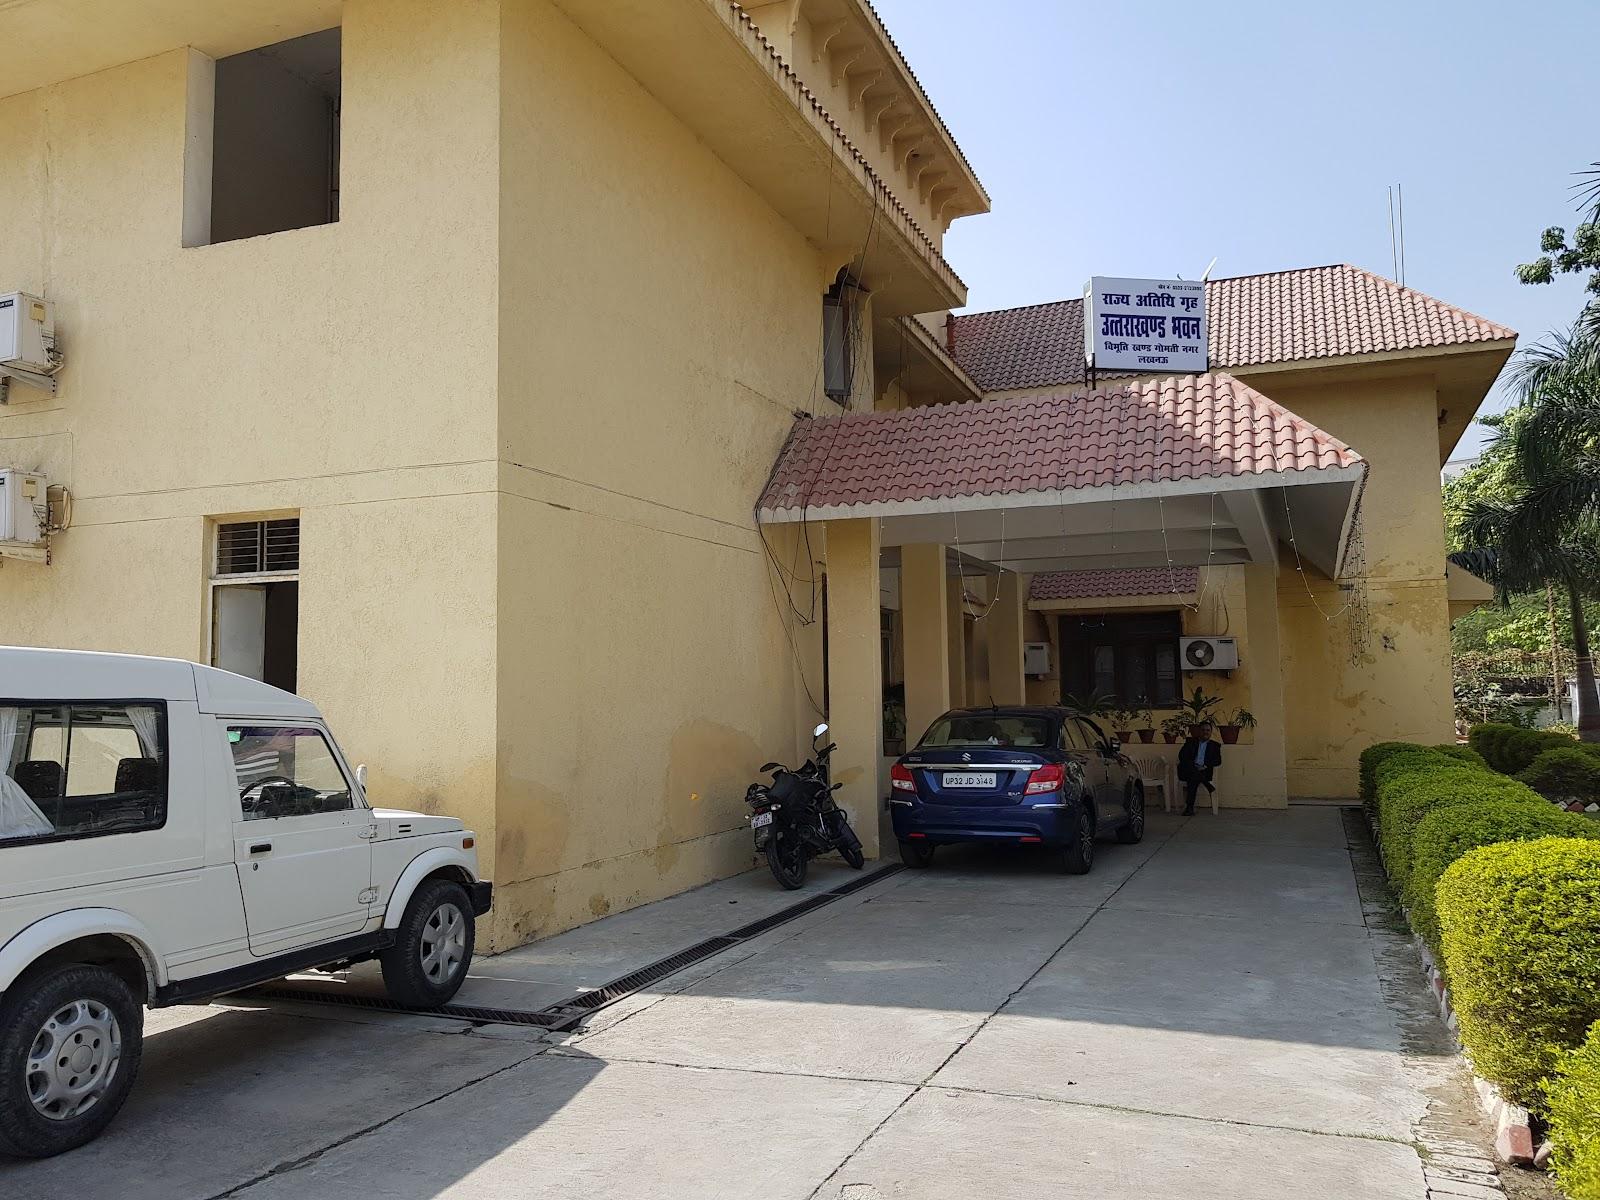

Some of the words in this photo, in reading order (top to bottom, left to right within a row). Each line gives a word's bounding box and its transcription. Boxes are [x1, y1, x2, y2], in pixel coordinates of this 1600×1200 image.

[1102, 293, 1131, 306] राज्य
[1179, 296, 1199, 312] गृह
[1172, 316, 1202, 339] भवन
[1154, 343, 1179, 353] गोमती
[1182, 345, 1199, 353] नगर
[1137, 355, 1169, 364] लखनऊ
[945, 777, 963, 785] UP32
[965, 777, 974, 785] JD
